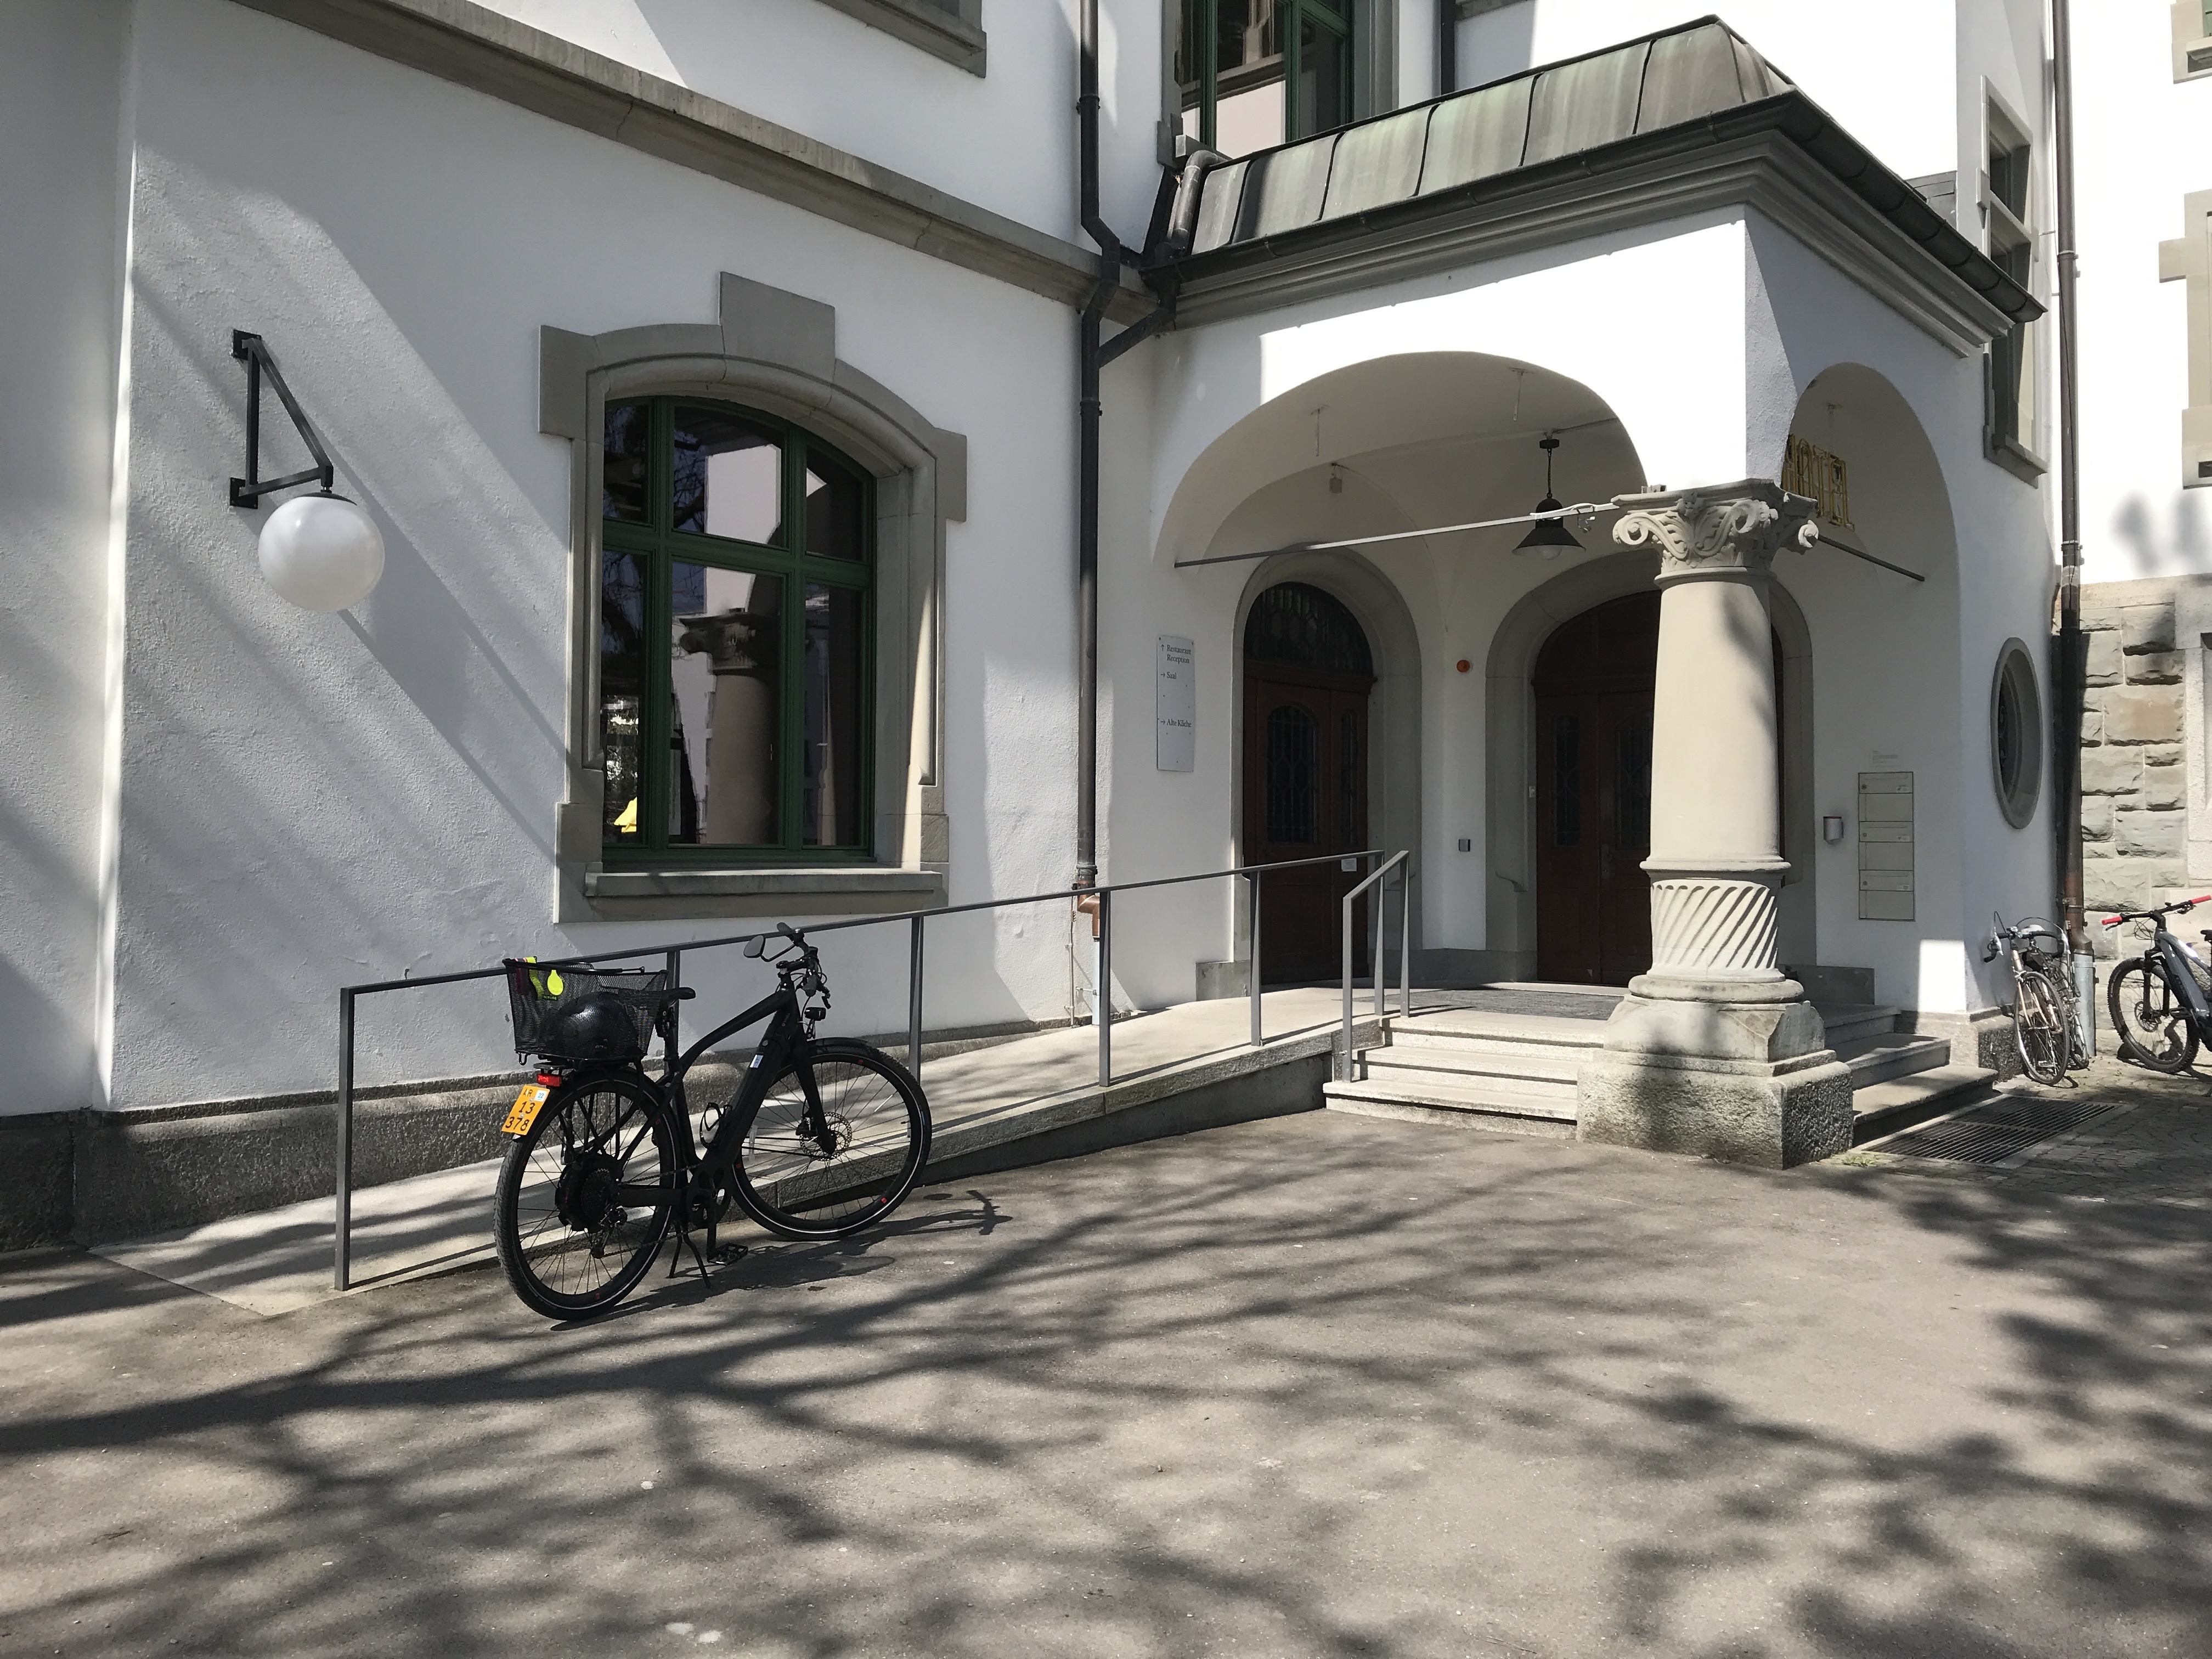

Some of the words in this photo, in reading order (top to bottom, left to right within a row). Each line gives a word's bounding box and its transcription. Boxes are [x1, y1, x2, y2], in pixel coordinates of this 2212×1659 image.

[1167, 645, 1191, 654] Restaurant
[1167, 654, 1189, 664] Reception
[1178, 719, 1191, 727] Küche
[523, 1088, 533, 1097] AR
[519, 1101, 535, 1114] 13
[505, 1116, 529, 1131] 378
